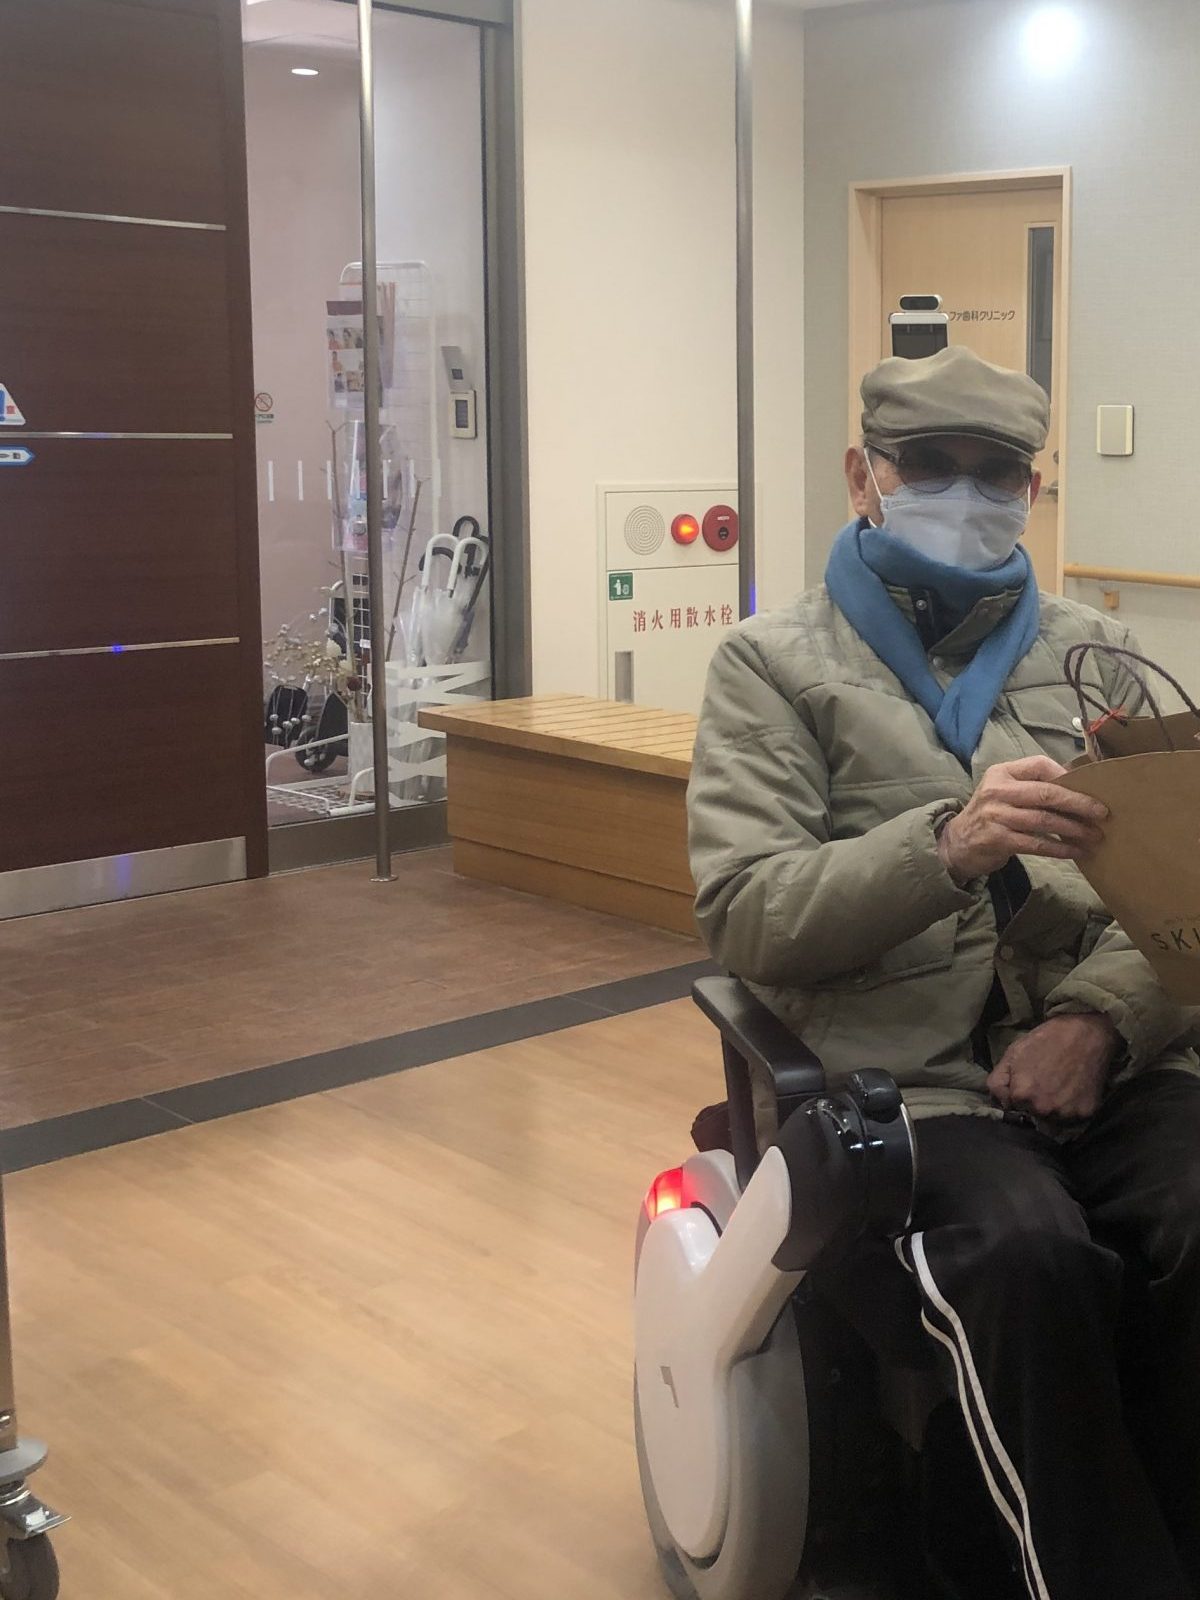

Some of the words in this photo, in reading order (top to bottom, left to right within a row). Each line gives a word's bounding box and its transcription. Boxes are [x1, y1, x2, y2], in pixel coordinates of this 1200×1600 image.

[633, 604, 733, 632] 消火用散水栓
